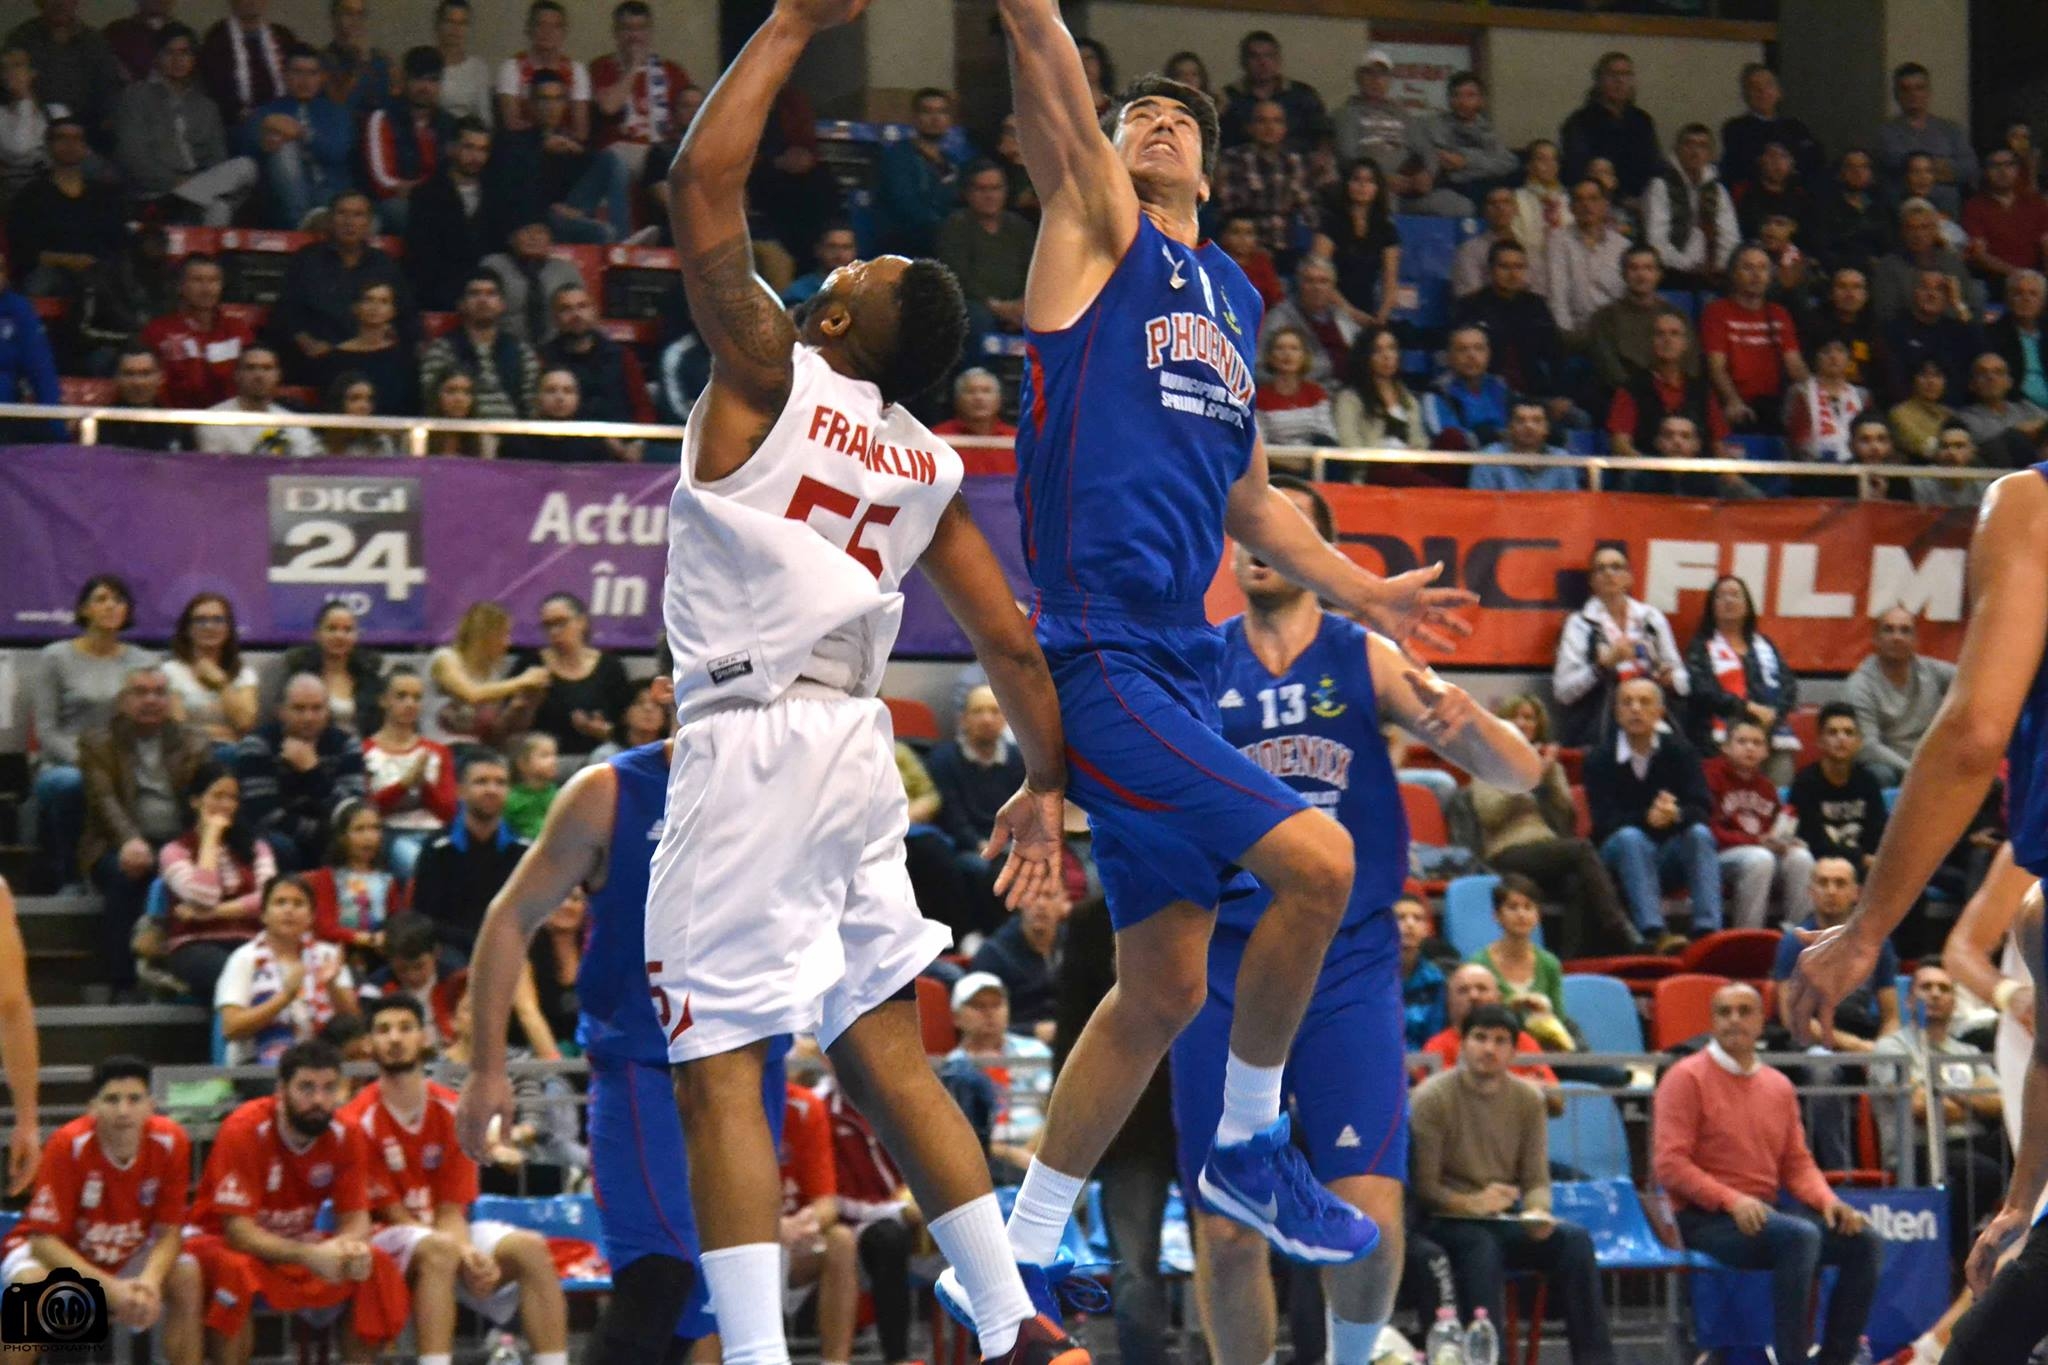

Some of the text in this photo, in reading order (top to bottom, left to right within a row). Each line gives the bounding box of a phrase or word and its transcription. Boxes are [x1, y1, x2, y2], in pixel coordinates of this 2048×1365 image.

[1145, 312, 1255, 406] PHOENIX
[286, 486, 407, 513] DIGI
[529, 491, 669, 545] Actu
[267, 520, 427, 601] 24
[1336, 533, 1968, 622] IG FILM
[590, 560, 648, 617] în
[1257, 683, 1306, 729] 13
[1238, 734, 1354, 789] OENIX
[1868, 1203, 1938, 1242] lten
